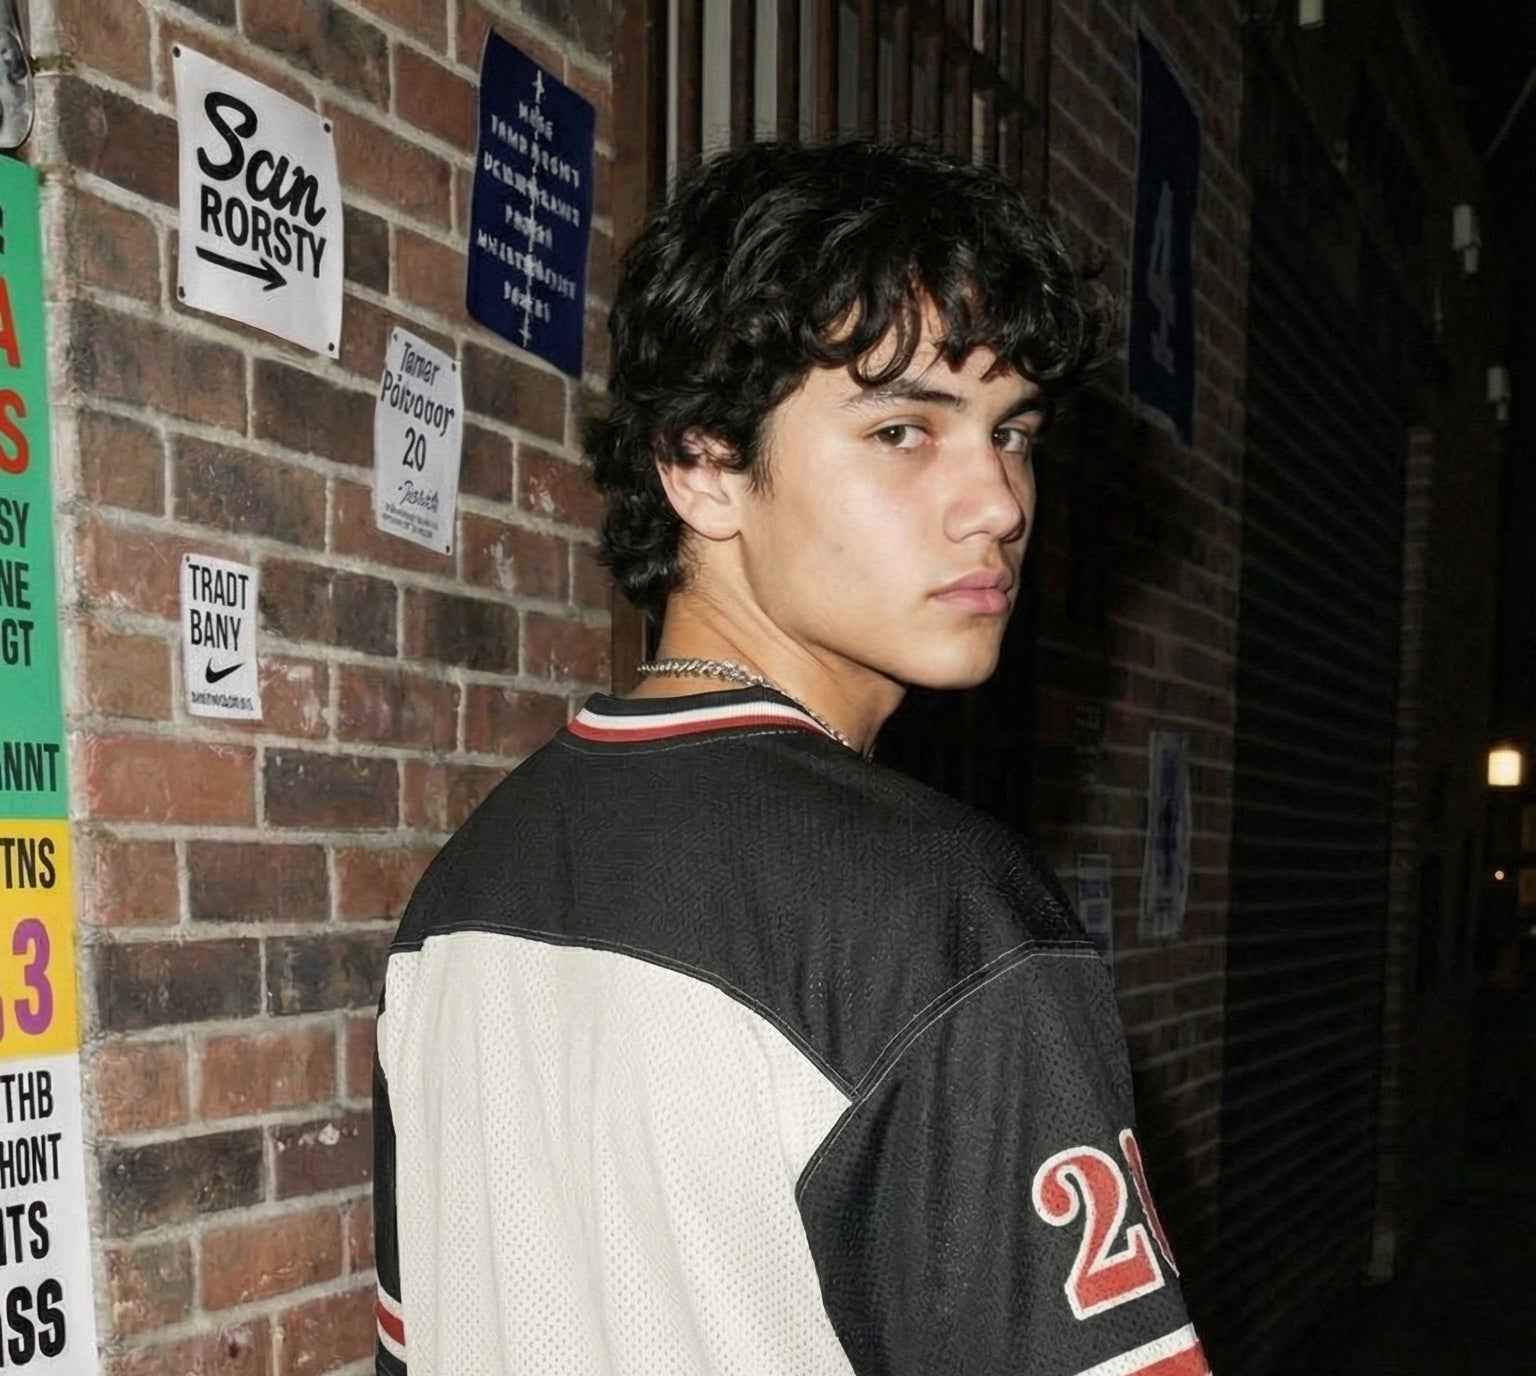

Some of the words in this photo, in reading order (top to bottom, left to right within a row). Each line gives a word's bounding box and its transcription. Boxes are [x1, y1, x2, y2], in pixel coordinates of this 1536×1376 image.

[200, 184, 327, 279] RORSTY
[402, 426, 427, 472] 20
[188, 563, 249, 611] TRADT
[1, 618, 34, 668] GT
[190, 608, 242, 652] BANY
[0, 741, 60, 793] NNT
[0, 837, 56, 890] TNS
[0, 1070, 54, 1124] THB
[1032, 1128, 1181, 1321] 2
[0, 1278, 67, 1369] SS
